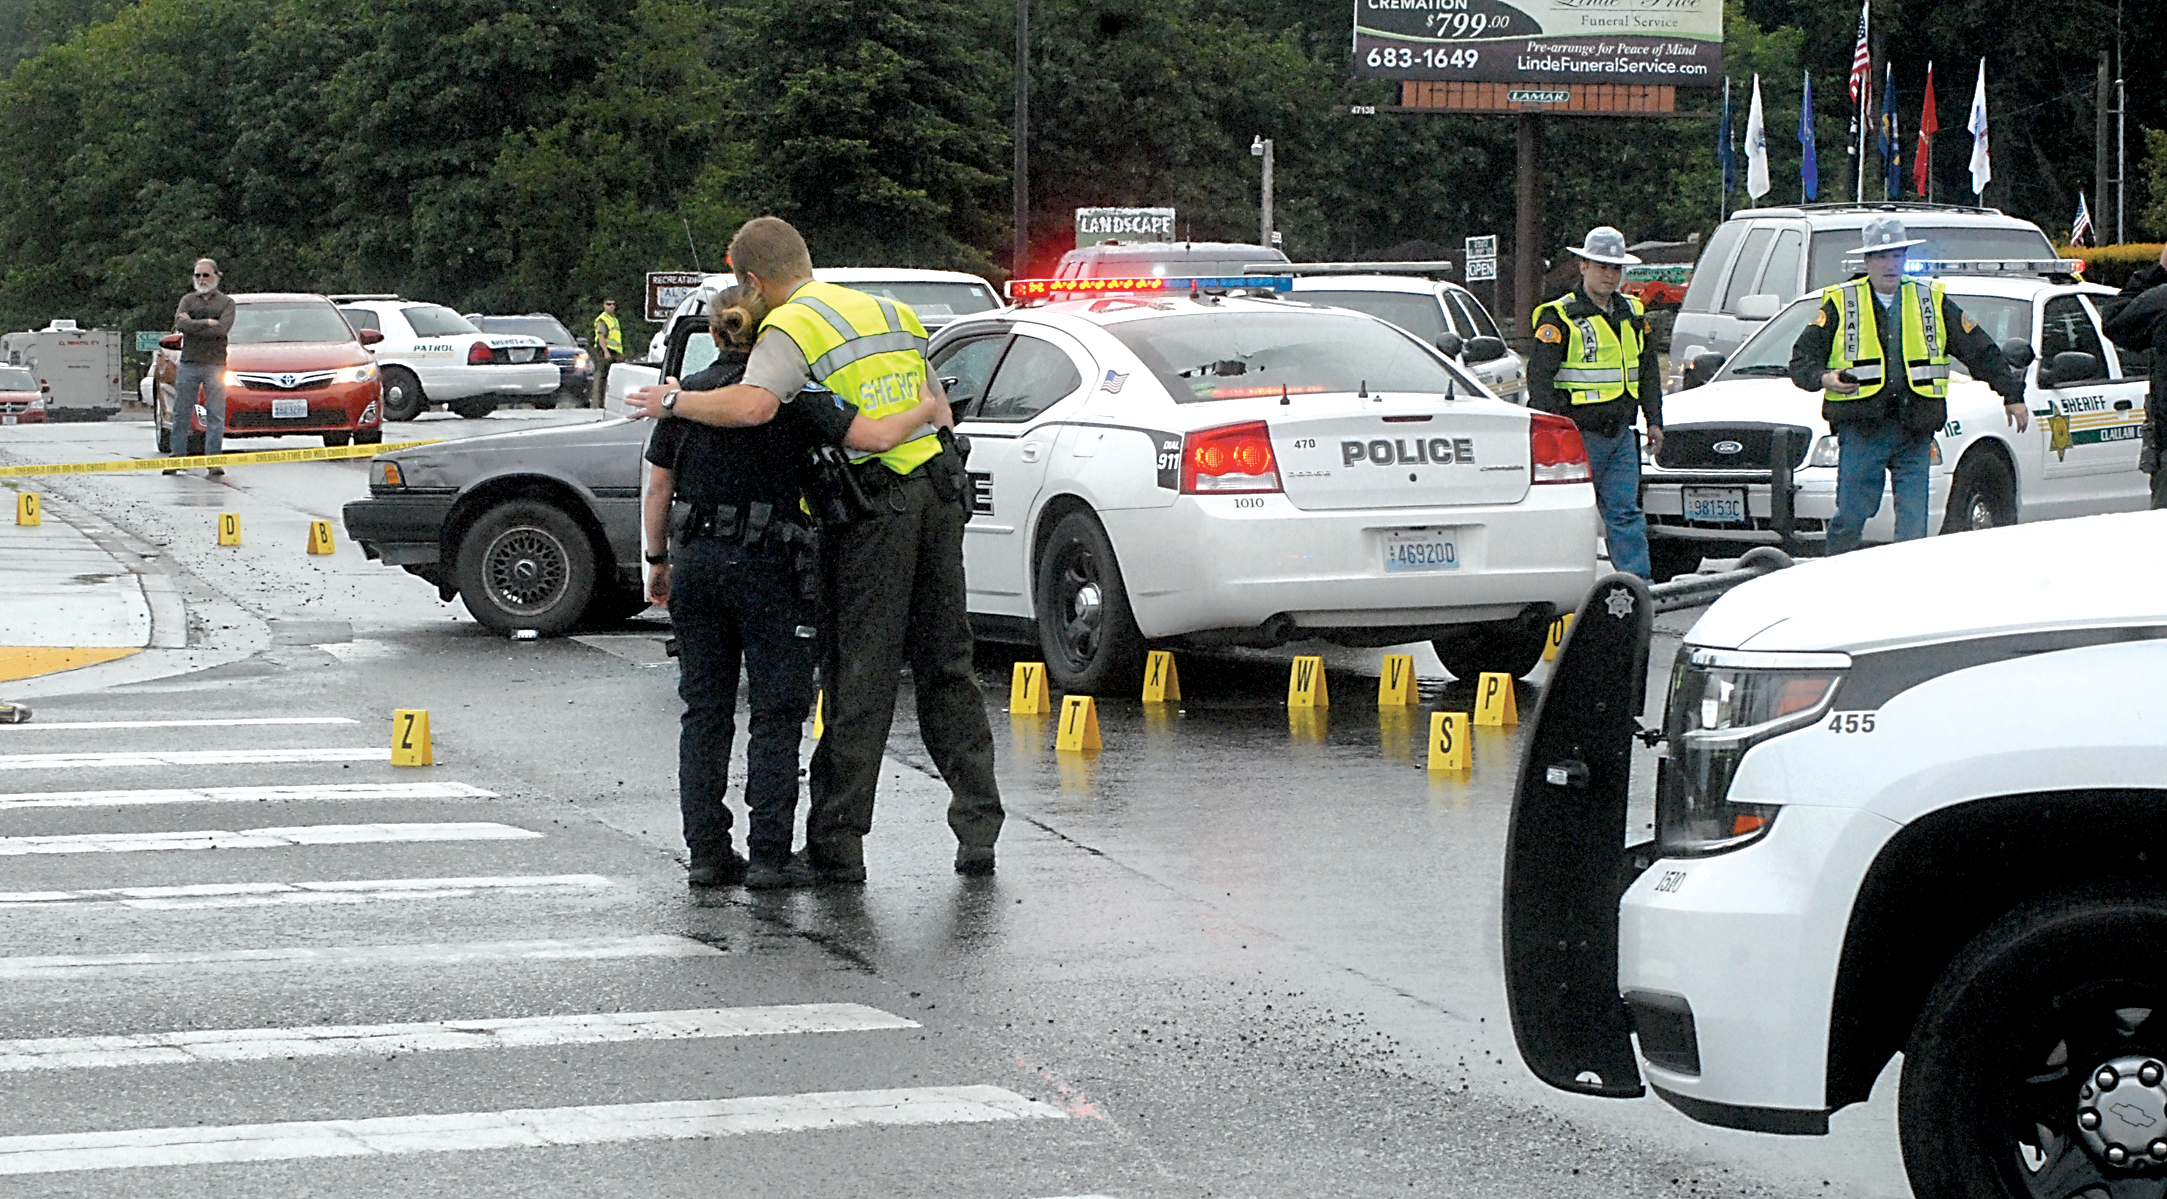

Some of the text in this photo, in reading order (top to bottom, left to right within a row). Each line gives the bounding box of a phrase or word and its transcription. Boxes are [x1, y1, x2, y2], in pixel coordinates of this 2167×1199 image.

[1368, 0, 1468, 9] CREMATION
[1581, 15, 1678, 28] Funeral Service
[1366, 48, 1479, 69] 683-1649
[1527, 41, 1697, 56] Pre-arrange for Peace of Mind
[1518, 56, 1708, 75] LindeFuneralService.com
[1512, 92, 1564, 101] LAMAR
[1080, 215, 1172, 233] LANDSCAPE
[1469, 262, 1493, 276] OPEN
[1847, 300, 1856, 353] STATE
[1921, 297, 1938, 351] PATROL
[413, 344, 454, 352] PATROL
[2060, 395, 2106, 414] SHERIFF
[1294, 438, 1316, 449] 470
[2100, 427, 2135, 441] CLALLAM
[1163, 440, 1180, 450] DIAL
[1340, 438, 1475, 467] POLICE
[1157, 453, 1179, 470] 911
[26, 494, 34, 516] C
[1234, 497, 1265, 509] 1010
[1694, 499, 1740, 516] 98153C
[226, 515, 234, 535] D
[319, 522, 328, 544] B
[1398, 542, 1455, 564] 46920D
[1150, 654, 1163, 687] X
[1297, 659, 1314, 692] W
[1391, 658, 1402, 690] V
[1022, 666, 1034, 699] Y
[1484, 676, 1498, 710] P
[1069, 700, 1081, 735] T
[1828, 713, 1875, 734] 455
[401, 713, 415, 749] Z
[1440, 716, 1453, 754] S
[1654, 870, 1687, 894] 1510
